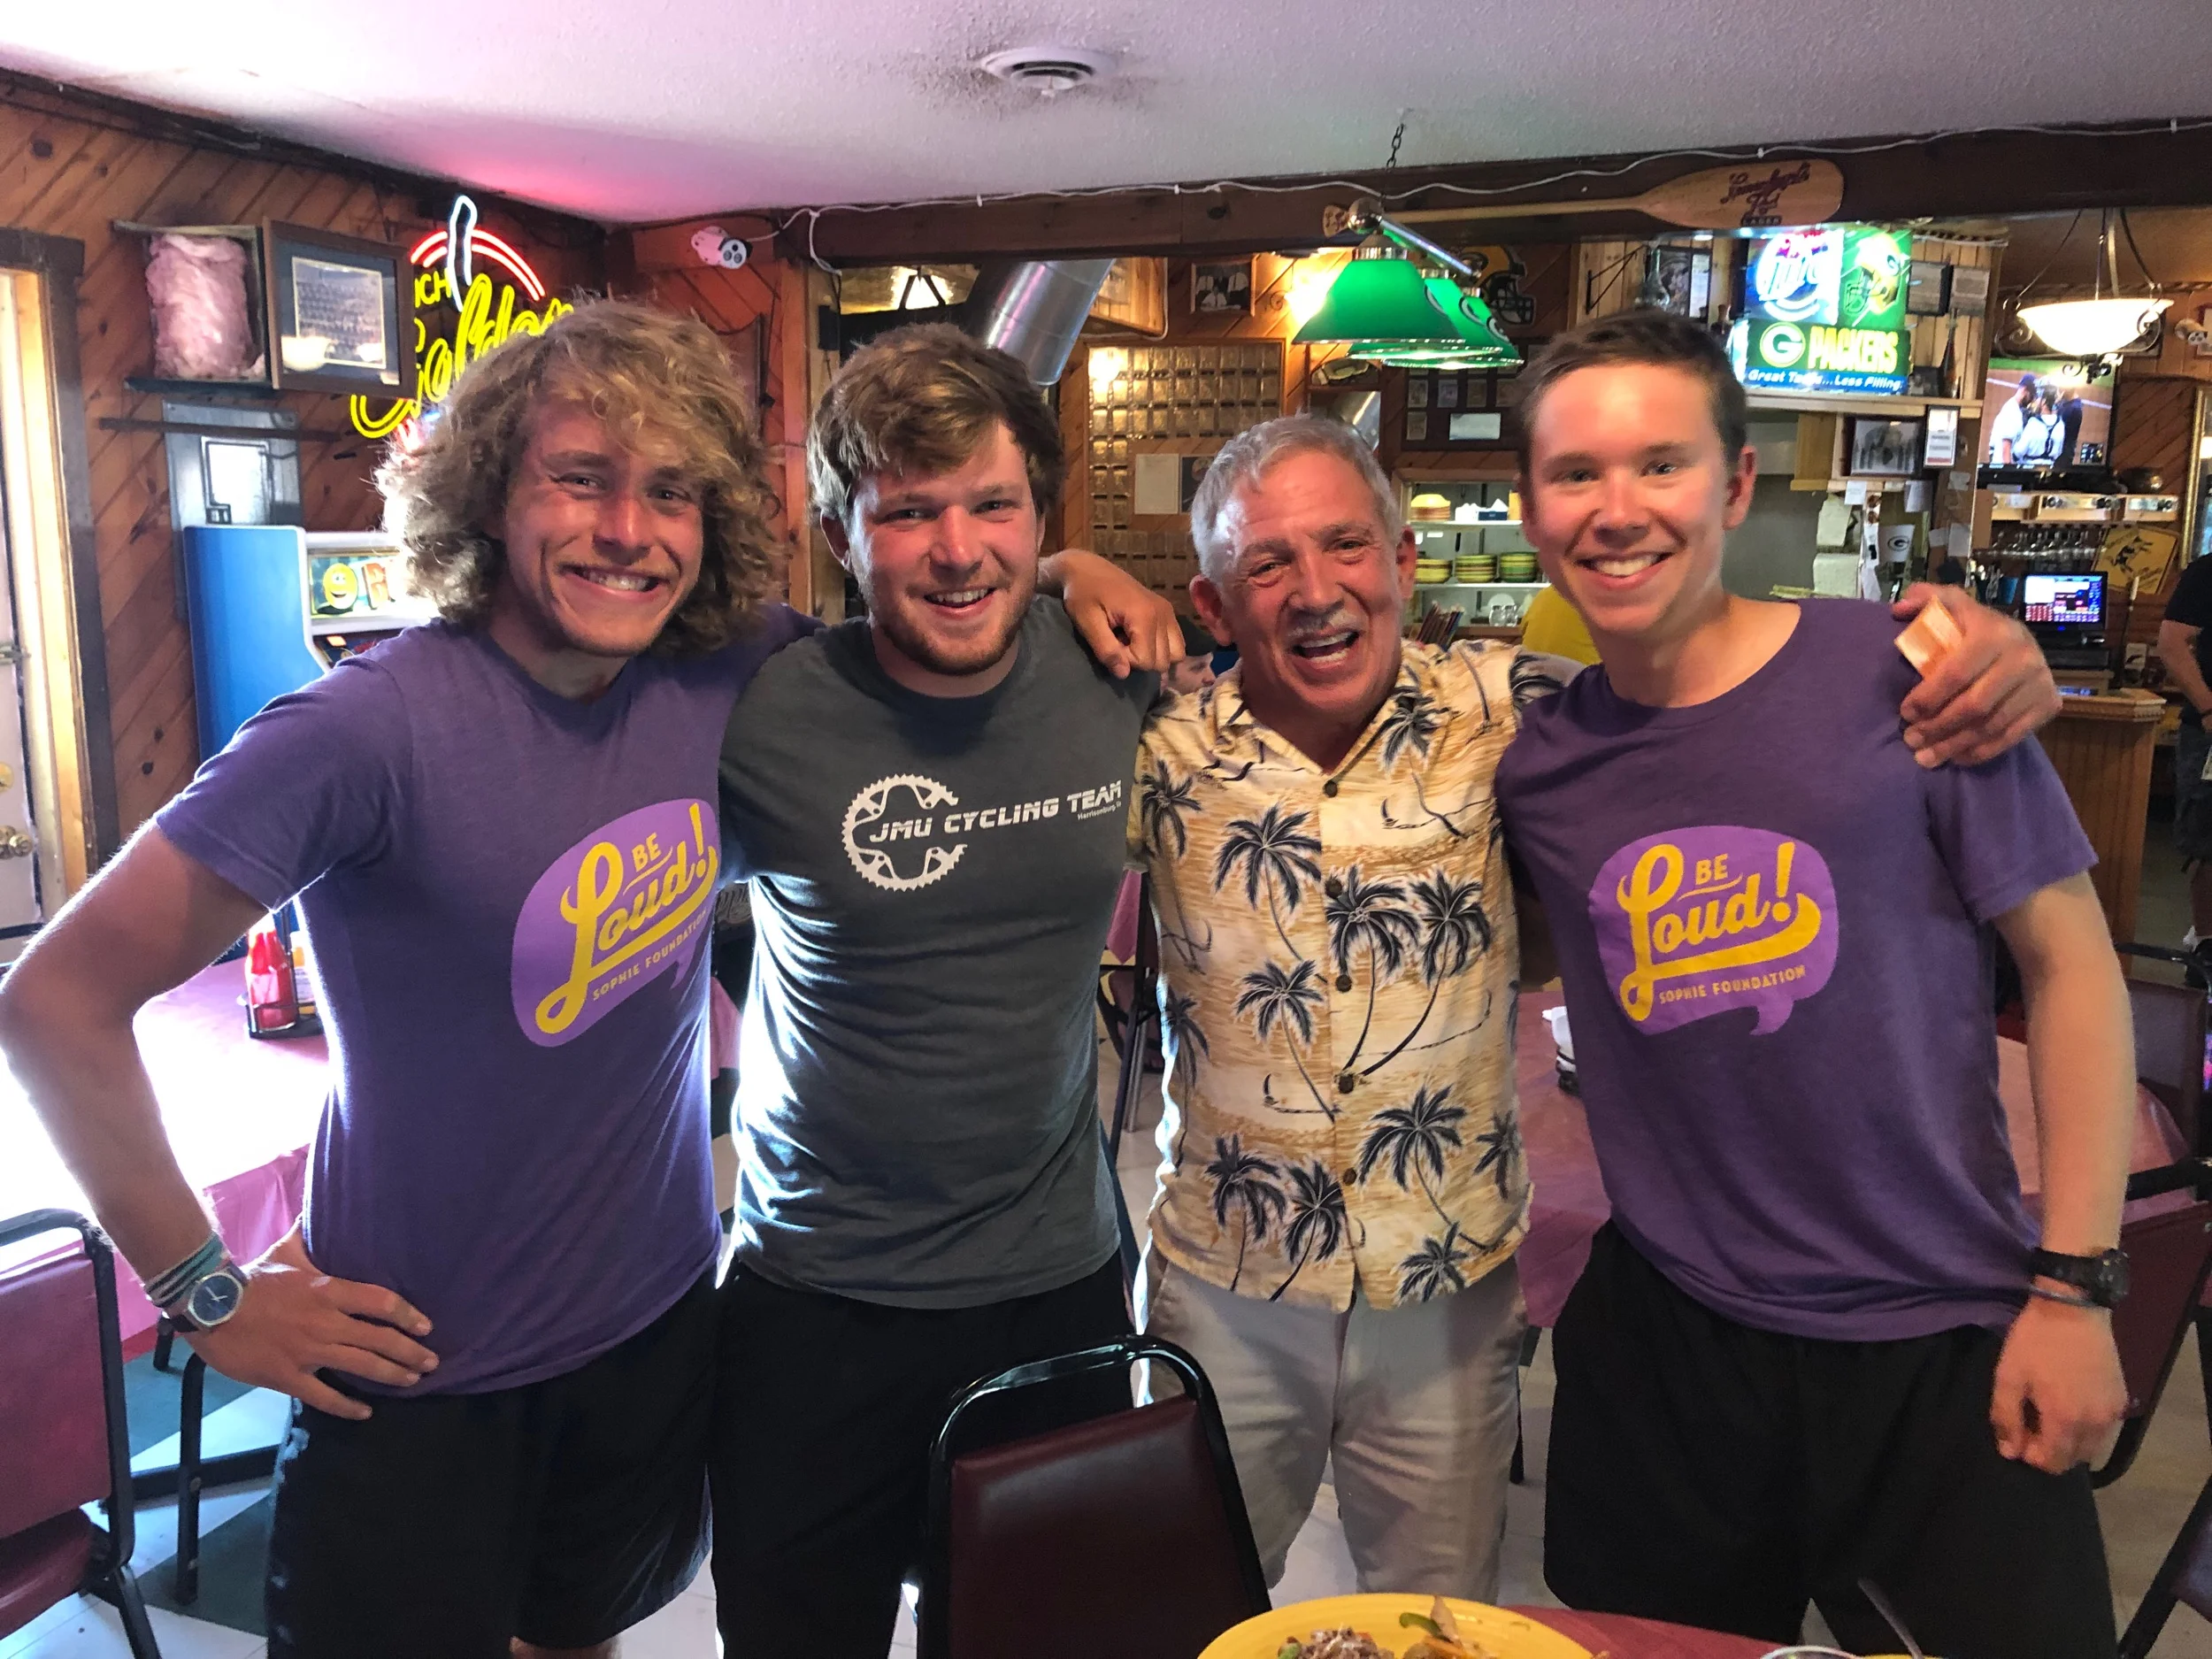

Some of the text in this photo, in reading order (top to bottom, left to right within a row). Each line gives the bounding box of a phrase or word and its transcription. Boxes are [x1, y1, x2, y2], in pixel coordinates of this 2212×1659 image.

[415, 267, 453, 308] ICH
[1808, 326, 1899, 373] PACKERS
[1747, 369, 1786, 383] Great
[869, 780, 1122, 843] JMU CYCLING TEAM
[631, 831, 662, 872] BE
[1695, 853, 1729, 886] BE
[593, 910, 707, 1002] SOPHIE FOUNDATION
[1658, 964, 1807, 1005] SOPHIE FOUNDATION
